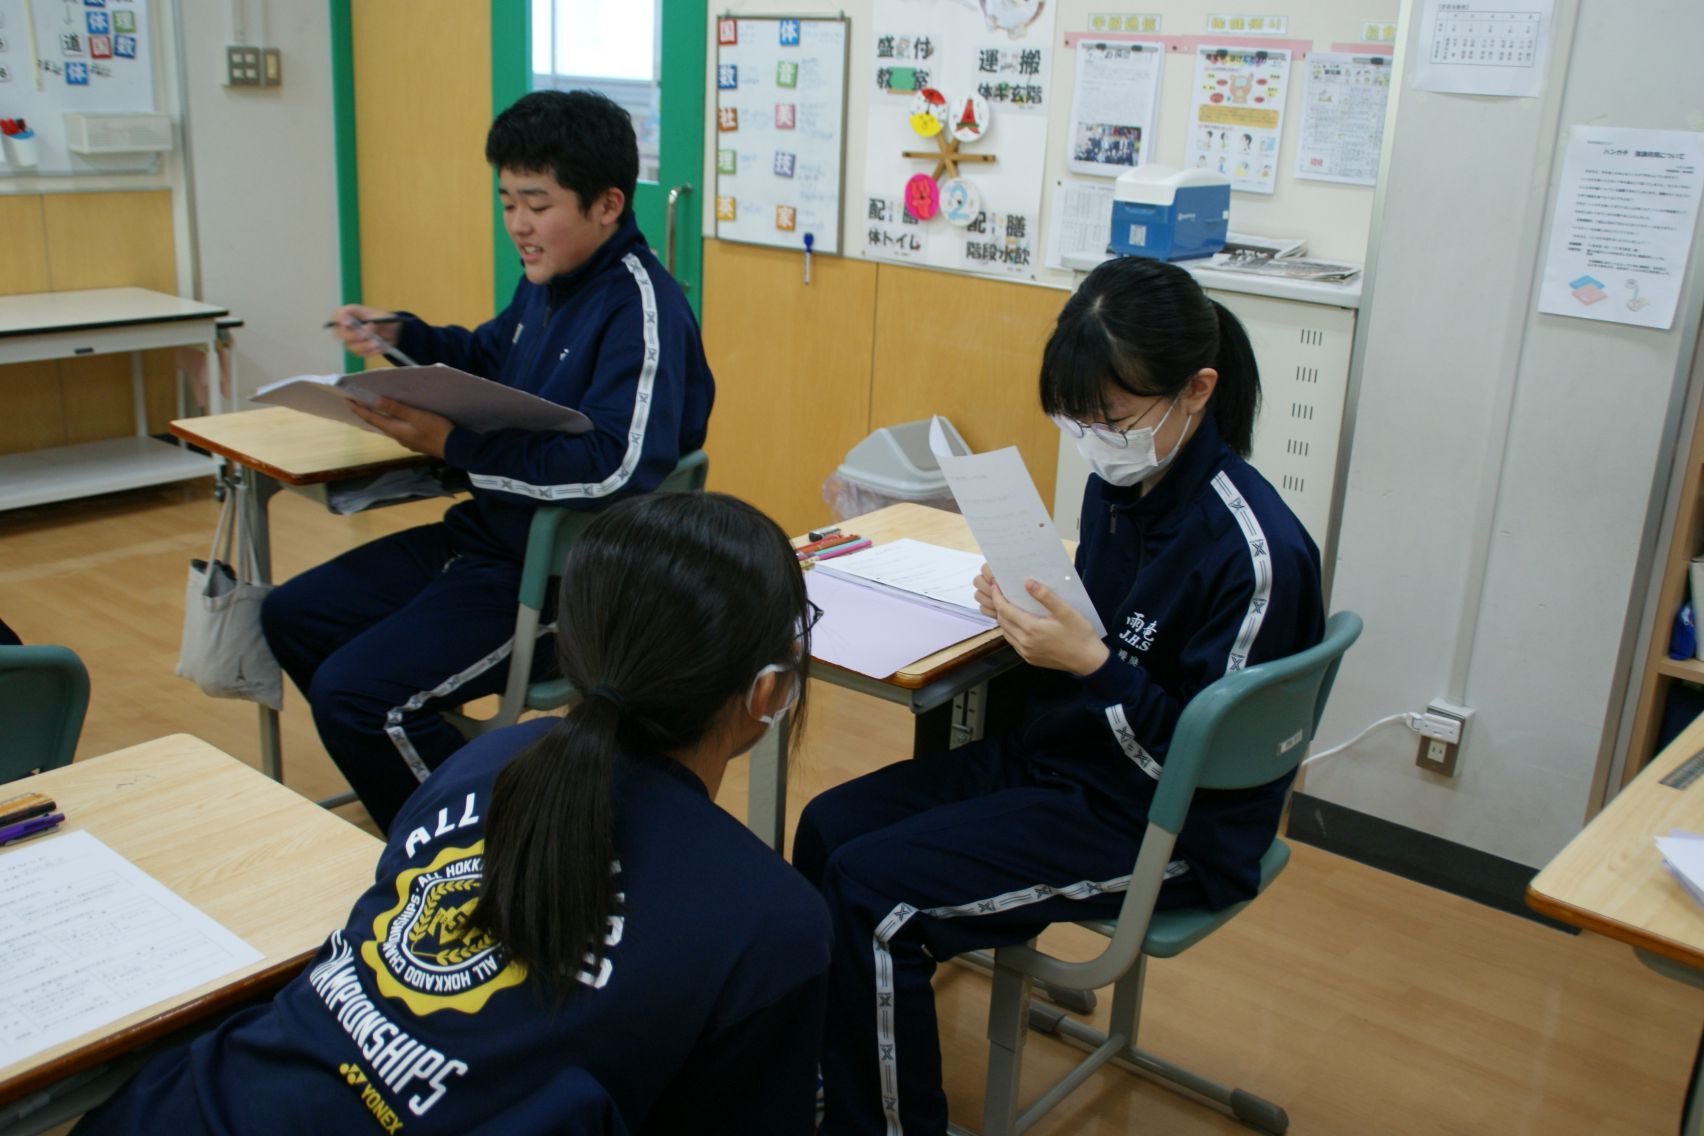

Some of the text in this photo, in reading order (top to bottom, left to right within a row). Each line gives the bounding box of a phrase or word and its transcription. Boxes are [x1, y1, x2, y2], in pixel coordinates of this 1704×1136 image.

[781, 20, 797, 43] 体
[877, 36, 931, 59] 盛付
[979, 49, 1040, 75] 運搬
[405, 792, 480, 859] ALL
[418, 857, 484, 888] ALL HOKK
[403, 966, 472, 993] HOKKAIDO
[472, 955, 498, 981] ALL
[360, 1084, 404, 1136] YONEX
